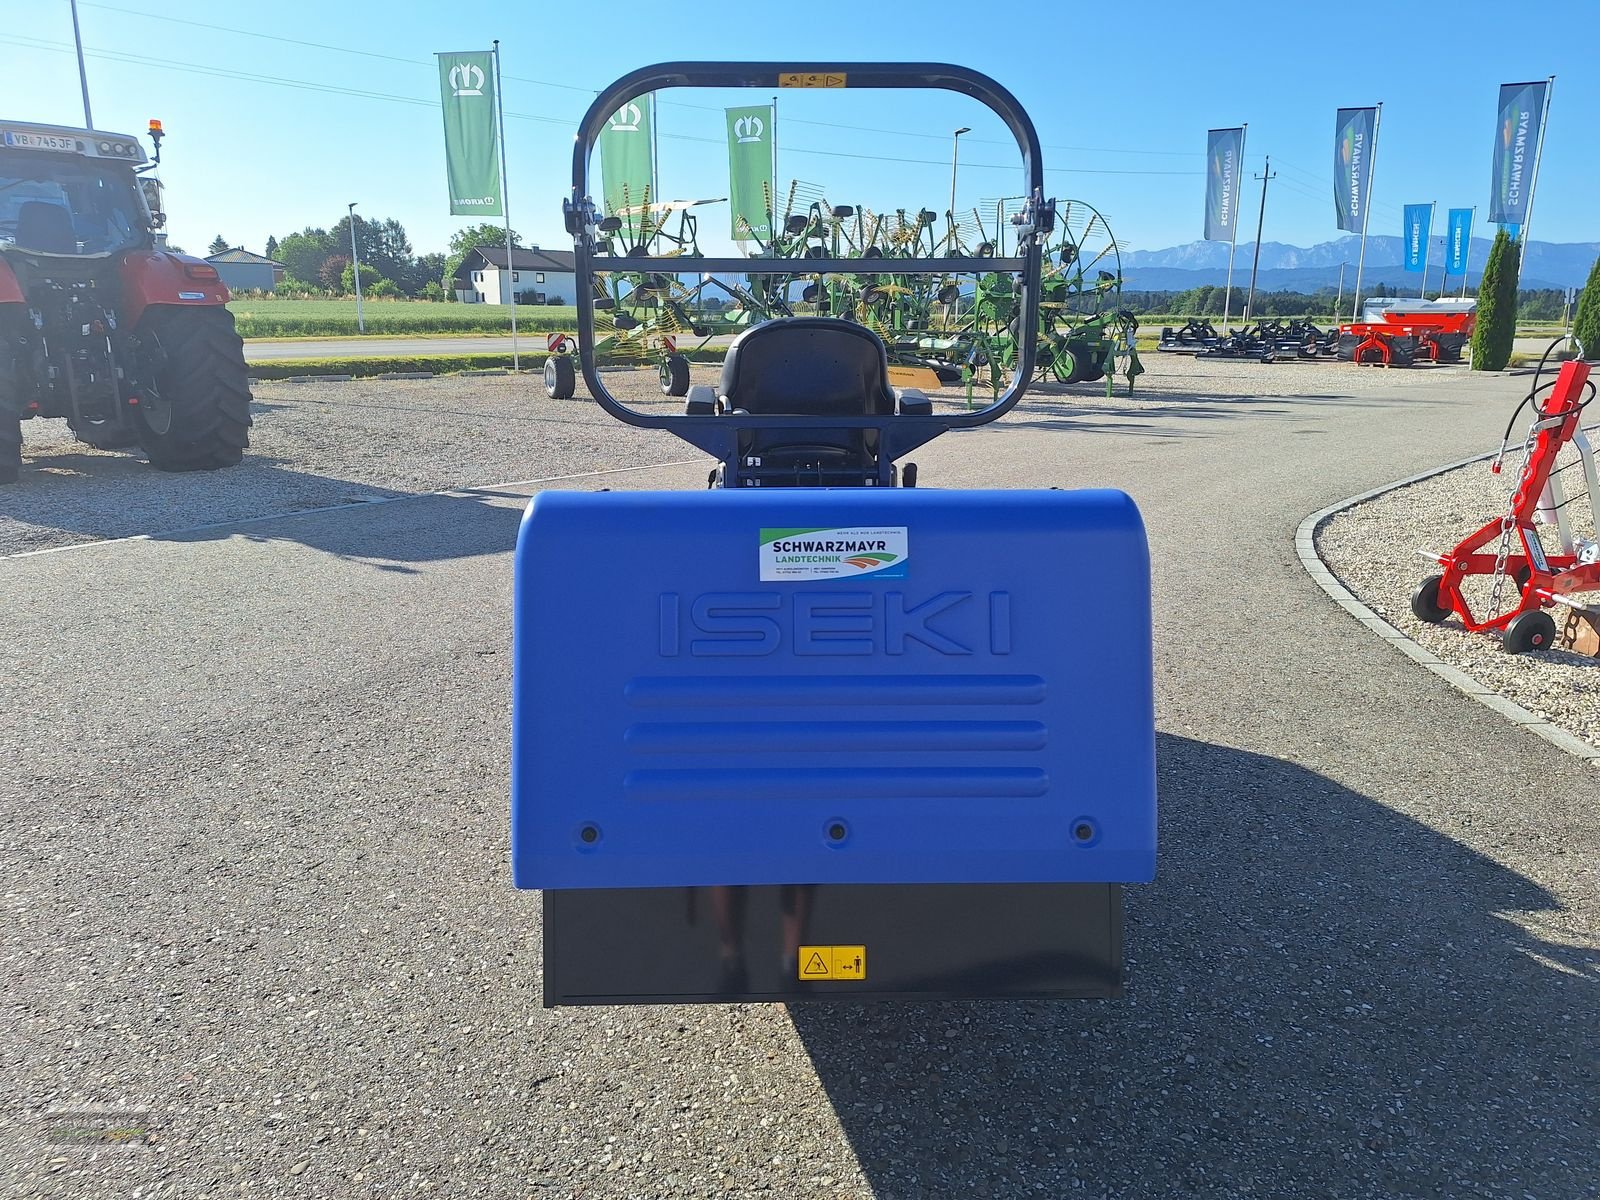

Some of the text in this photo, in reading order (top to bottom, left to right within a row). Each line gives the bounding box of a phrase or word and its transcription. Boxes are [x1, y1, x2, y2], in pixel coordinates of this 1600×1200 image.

[14, 134, 72, 149] VB 745 JF
[773, 540, 886, 553] SCHWARZMAYR
[775, 555, 842, 563] LANDTECHNIK
[658, 590, 1011, 657] ISEKI
